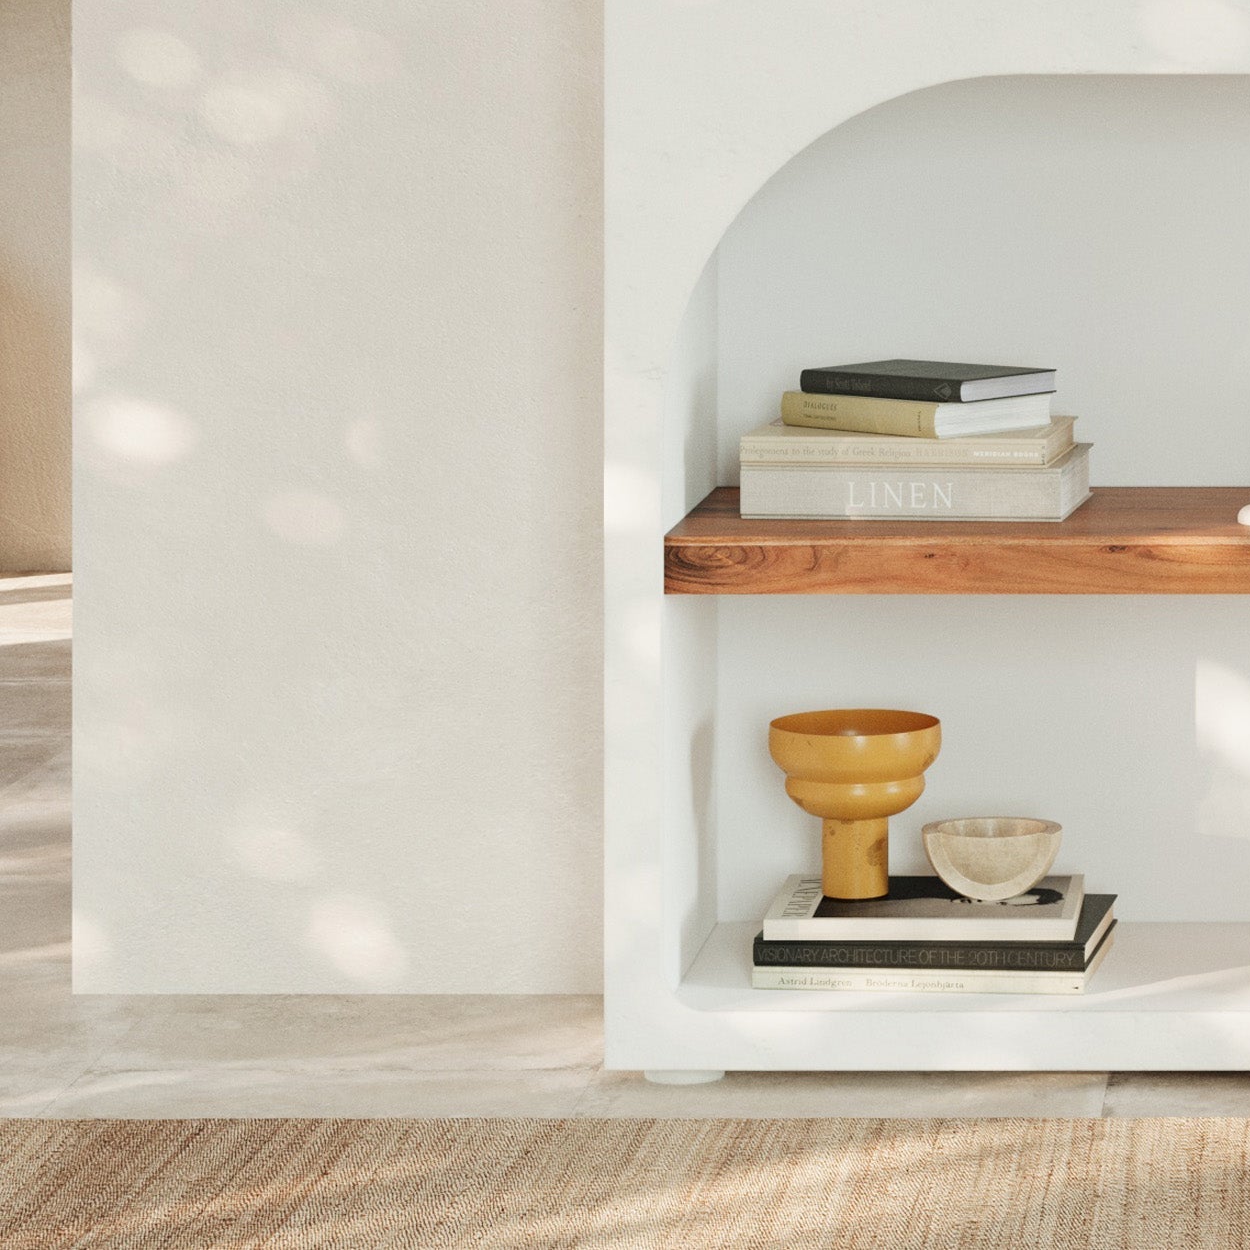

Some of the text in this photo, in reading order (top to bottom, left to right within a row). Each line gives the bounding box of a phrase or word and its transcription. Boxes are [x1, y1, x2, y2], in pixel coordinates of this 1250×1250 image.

[847, 481, 954, 509] LINEN
[757, 948, 818, 962] VISIONARY
[820, 948, 917, 964] ARCHITECTURE
[918, 949, 934, 965] OF
[936, 950, 965, 965] THE
[1007, 951, 1076, 967] CENTURY
[778, 976, 807, 986] Astrid
[809, 976, 852, 988] Lindgren
